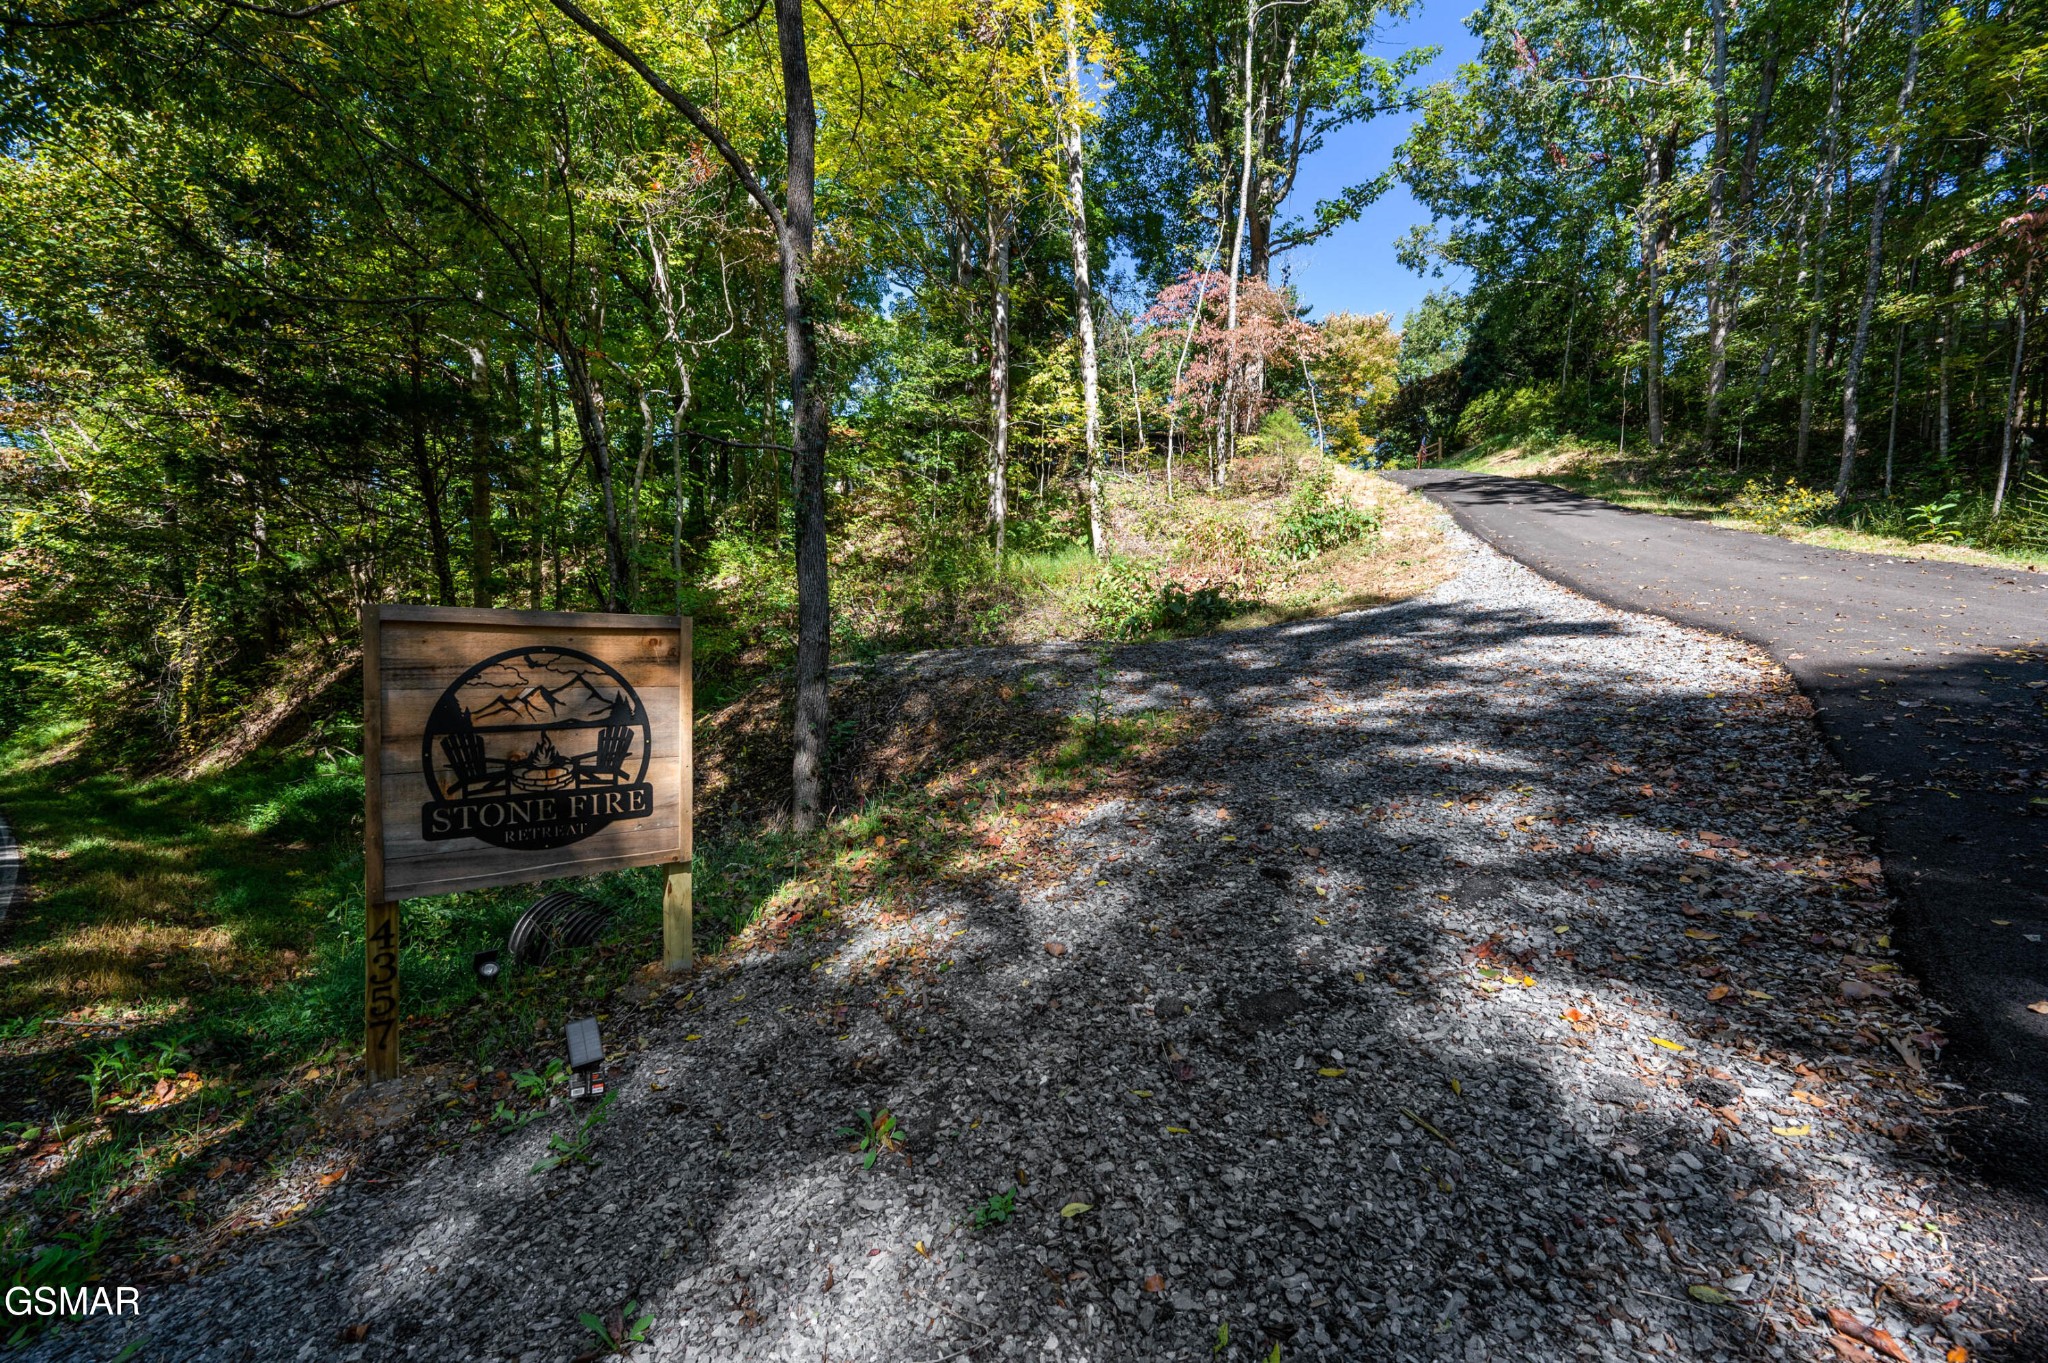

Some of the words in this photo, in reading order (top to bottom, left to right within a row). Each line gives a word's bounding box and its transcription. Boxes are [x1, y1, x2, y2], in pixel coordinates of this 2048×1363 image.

[432, 798, 557, 833] STONE
[568, 789, 646, 818] FIRE
[504, 822, 588, 843] RETREAT
[369, 919, 397, 1050] 4357
